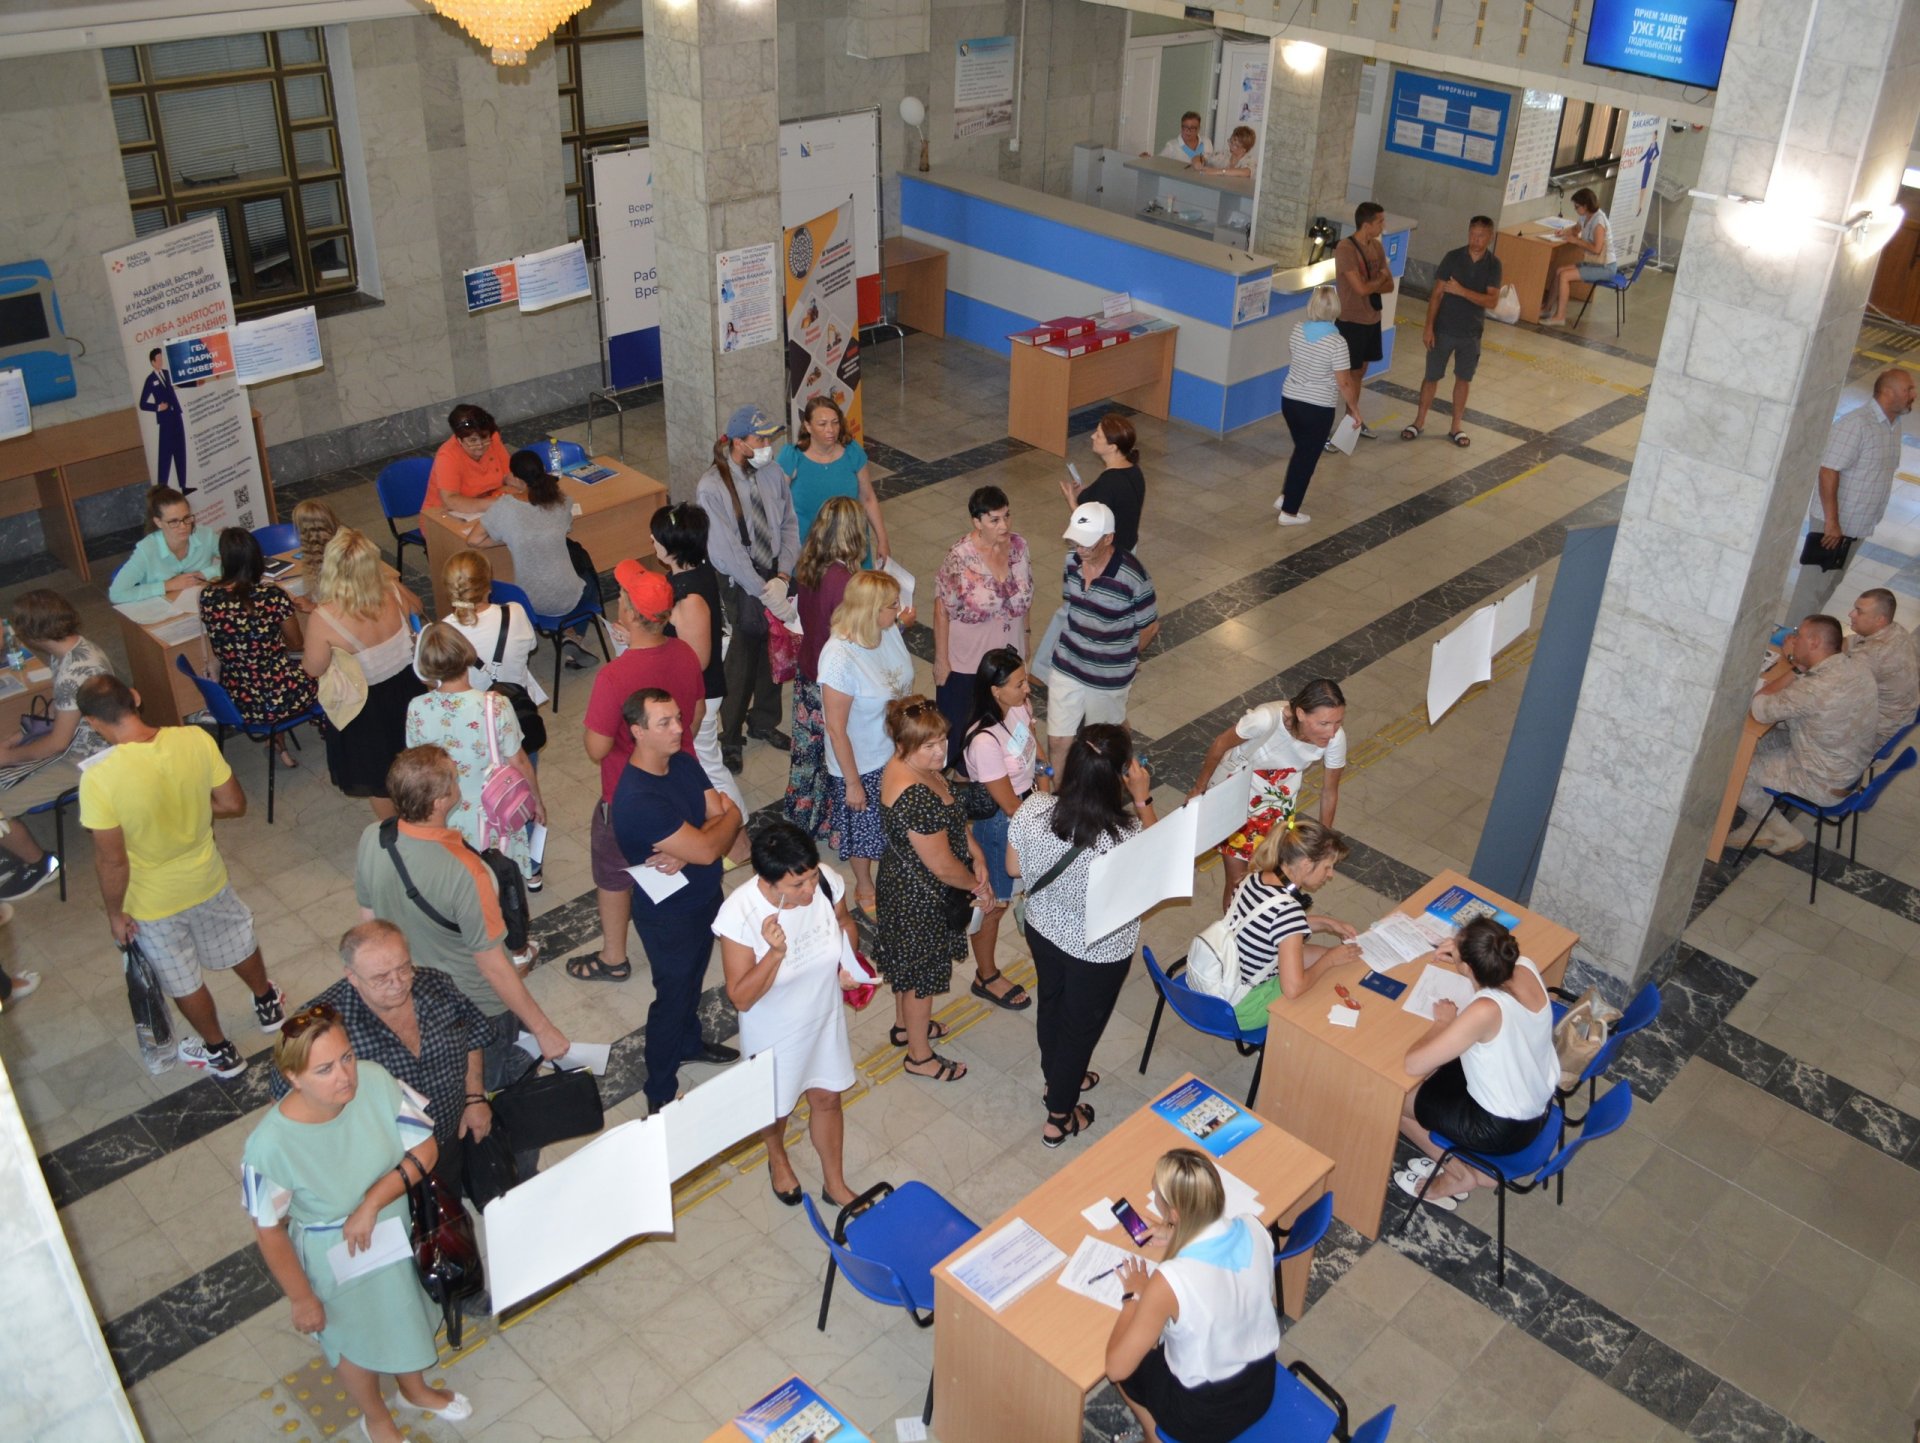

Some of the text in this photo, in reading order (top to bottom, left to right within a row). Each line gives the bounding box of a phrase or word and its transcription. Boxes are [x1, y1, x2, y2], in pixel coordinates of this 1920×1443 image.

[1659, 13, 1688, 26] ЗАЯВОК
[1631, 20, 1686, 42] УЖЕ ИДЁТ
[174, 266, 204, 283] БЫСТРЫЙ
[132, 291, 165, 310] УДОБНЫЙ
[165, 281, 194, 297] СПОСОБ
[195, 273, 214, 287] НАЙТИ
[123, 281, 222, 325] ДОСТОЙНУЮ РАБОТУ ДЛЯ ВСЕХ
[135, 301, 226, 343] СЛУЖБА ЗАНЯТОСТИ
[190, 343, 207, 353] ГБУ
[184, 351, 219, 365] «ПАРКИ
[178, 360, 227, 377] И СКВЕРЫ»
